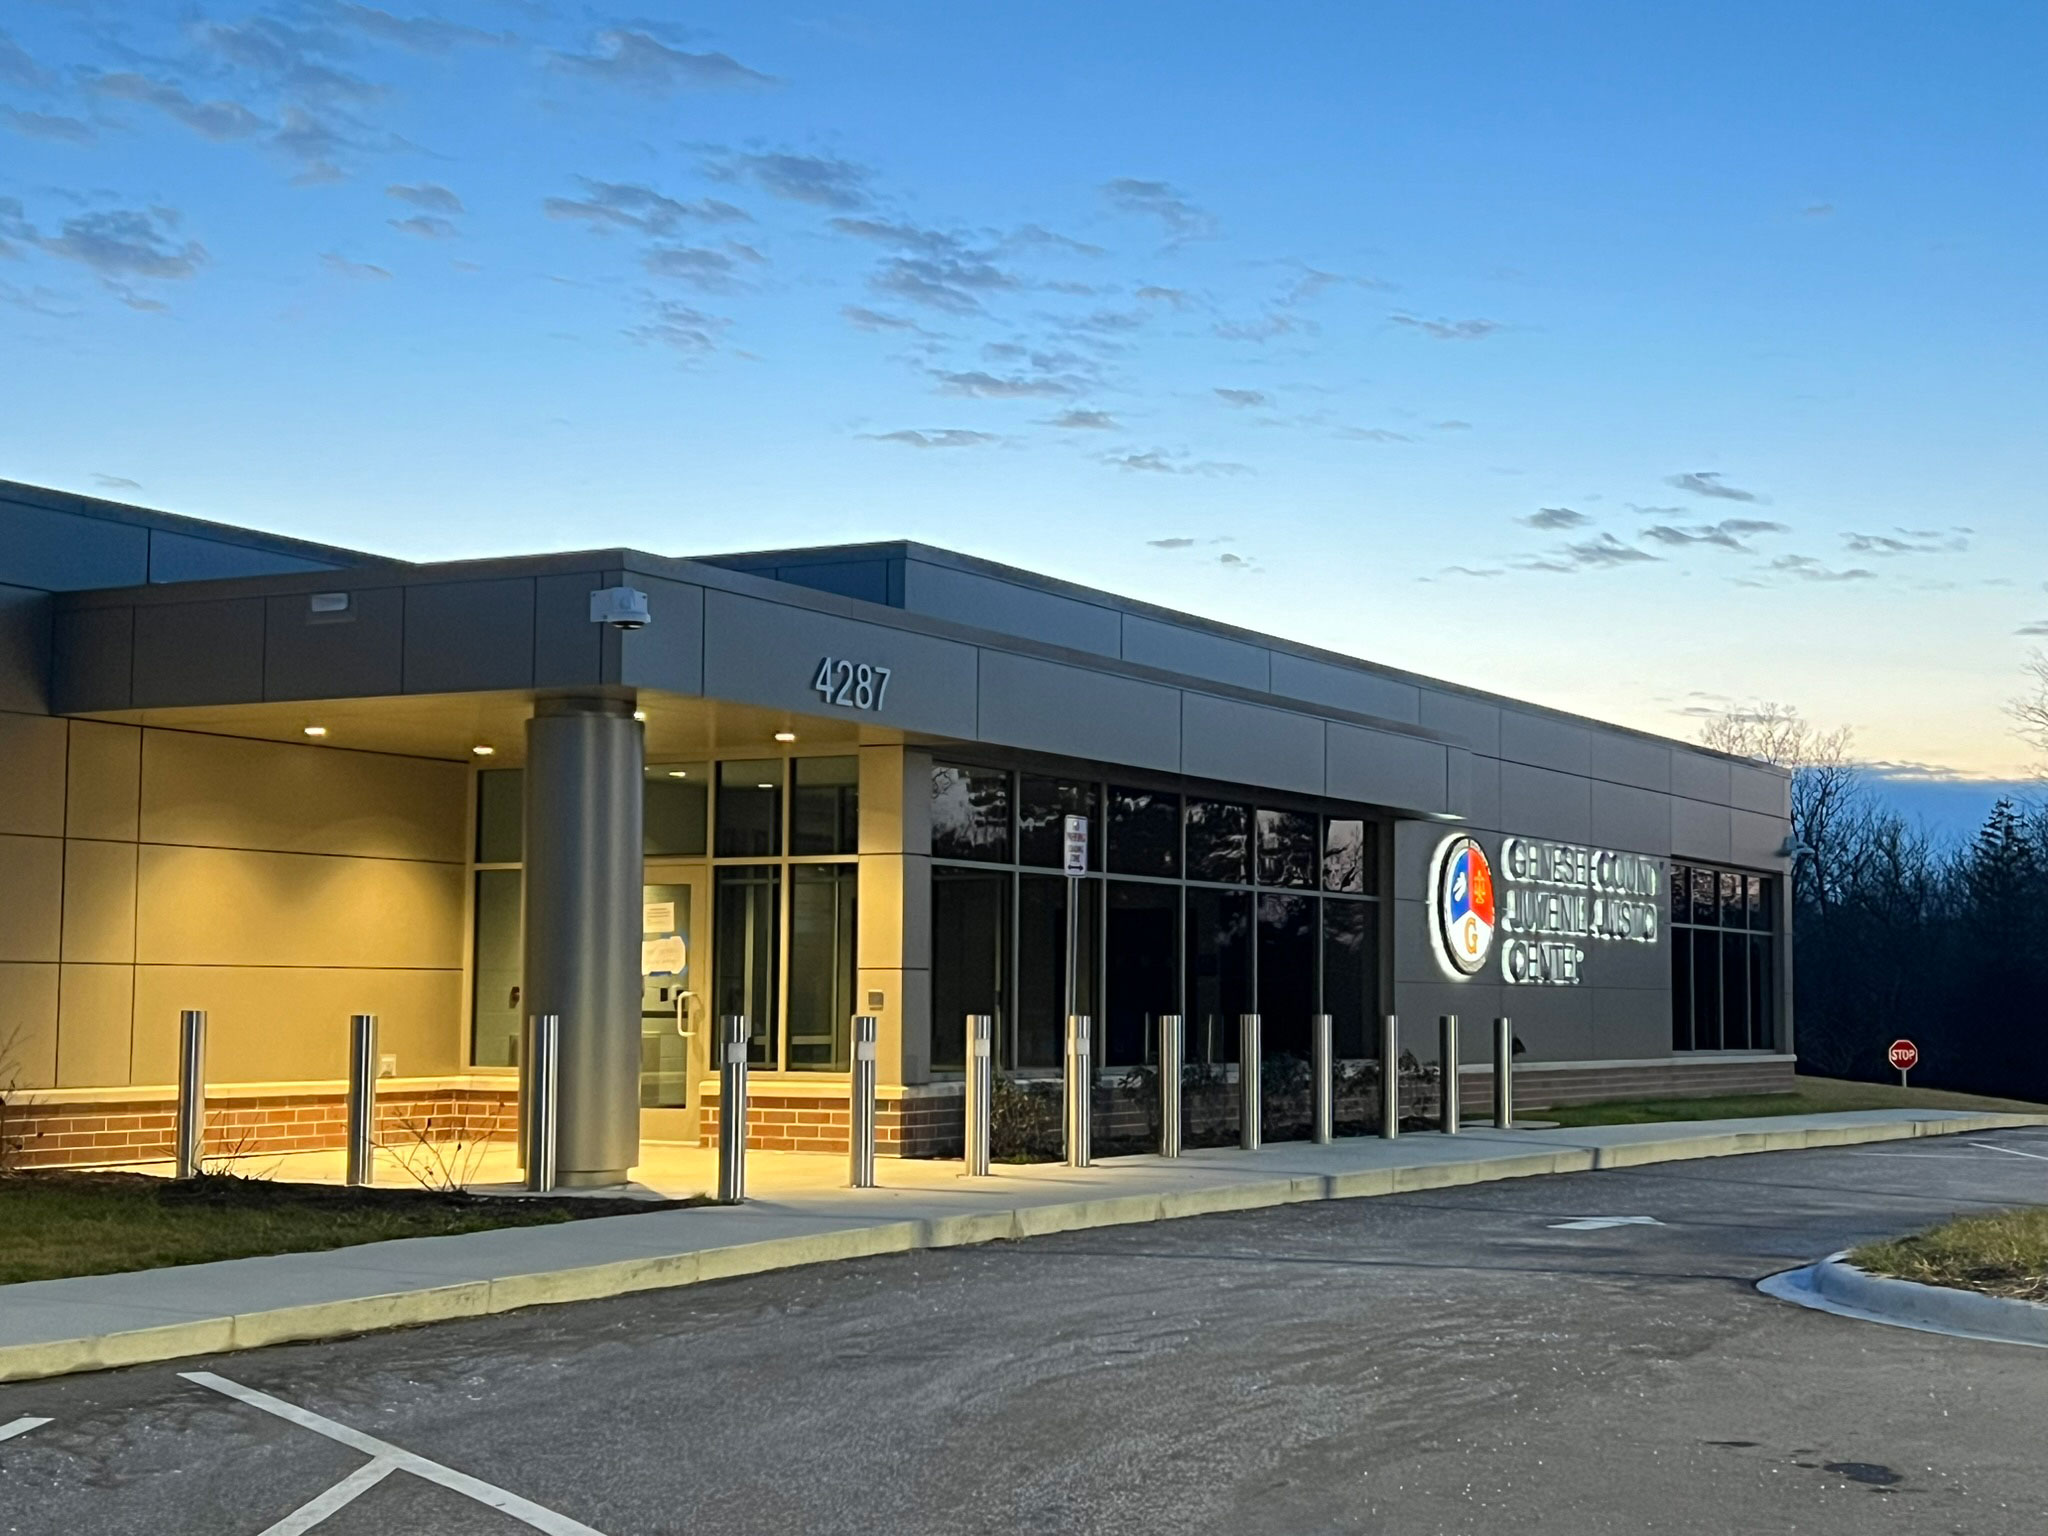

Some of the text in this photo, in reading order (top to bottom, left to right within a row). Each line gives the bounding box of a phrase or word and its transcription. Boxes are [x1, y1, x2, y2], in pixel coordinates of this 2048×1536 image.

[815, 657, 891, 711] 4287
[1464, 917, 1478, 954] G
[1891, 1049, 1915, 1061] STOP
